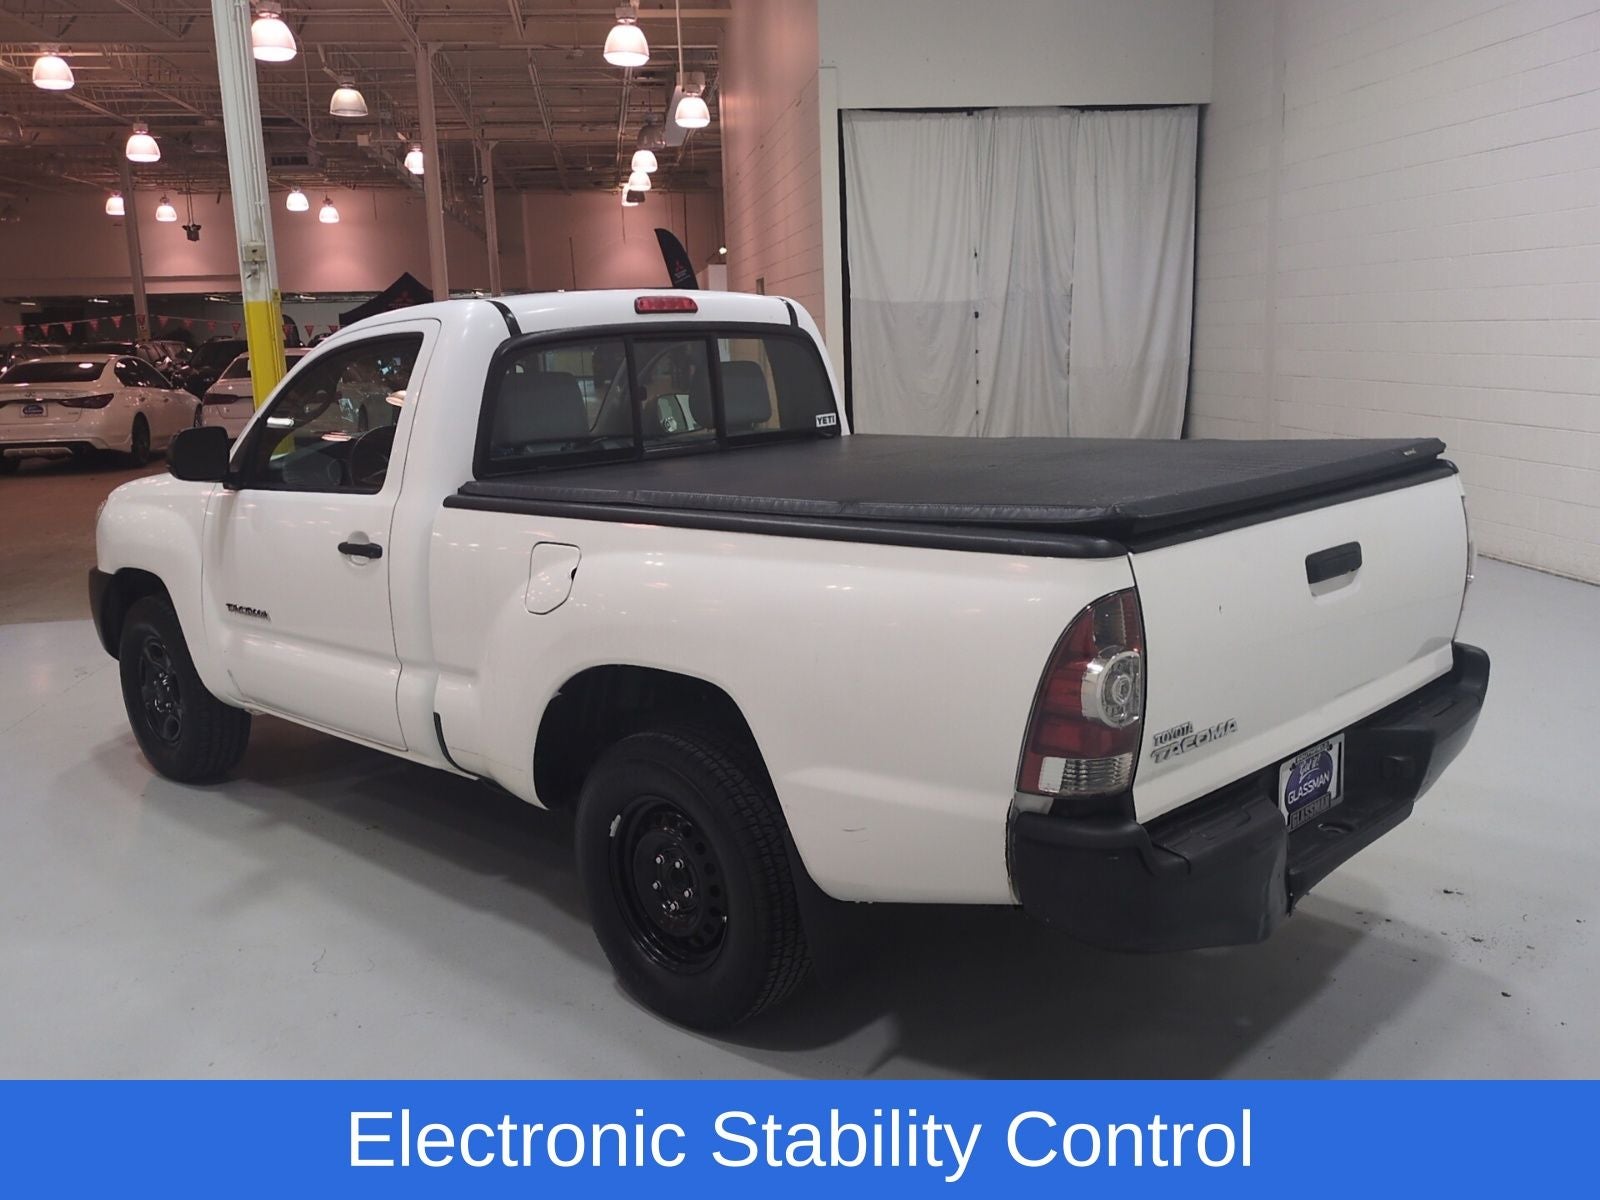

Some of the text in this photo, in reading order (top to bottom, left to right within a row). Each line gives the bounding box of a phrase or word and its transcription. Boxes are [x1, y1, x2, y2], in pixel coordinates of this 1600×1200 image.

[817, 415, 835, 425] YETI
[1150, 717, 1238, 763] TACOMA
[1153, 721, 1193, 746] TOYOTA
[1287, 770, 1330, 804] GLASSMAN
